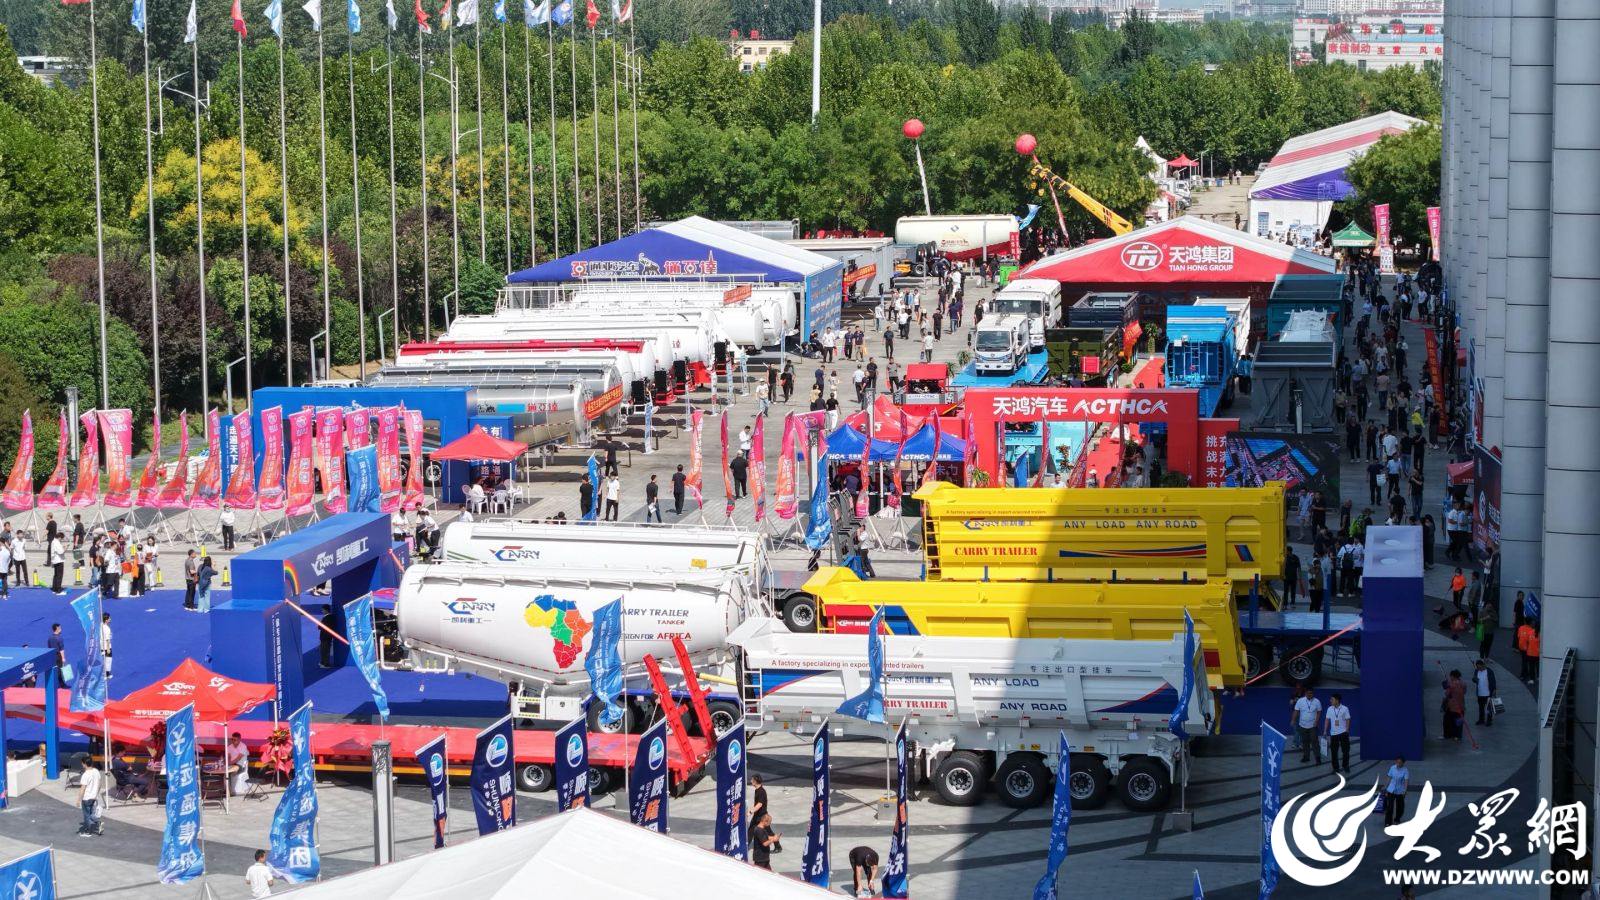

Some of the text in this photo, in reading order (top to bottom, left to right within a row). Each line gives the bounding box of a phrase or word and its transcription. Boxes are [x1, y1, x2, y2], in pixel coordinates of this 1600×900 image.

[1169, 246, 1234, 263] 天鸿集团
[992, 396, 1069, 416] 天鸿汽车
[1073, 398, 1168, 415] ACTHCA
[1064, 520, 1198, 529] ANY LOAD ANY ROAD
[955, 547, 1037, 556] CARRY TRAILER
[620, 608, 690, 618] ARRY TRAILER
[778, 659, 801, 668] factory
[802, 660, 841, 670] specializing
[1030, 665, 1113, 674] 专注出口型挂车
[974, 677, 1039, 687] ANY LOAD
[905, 700, 947, 709] TRAILER
[1000, 702, 1067, 711] ANY ROAD
